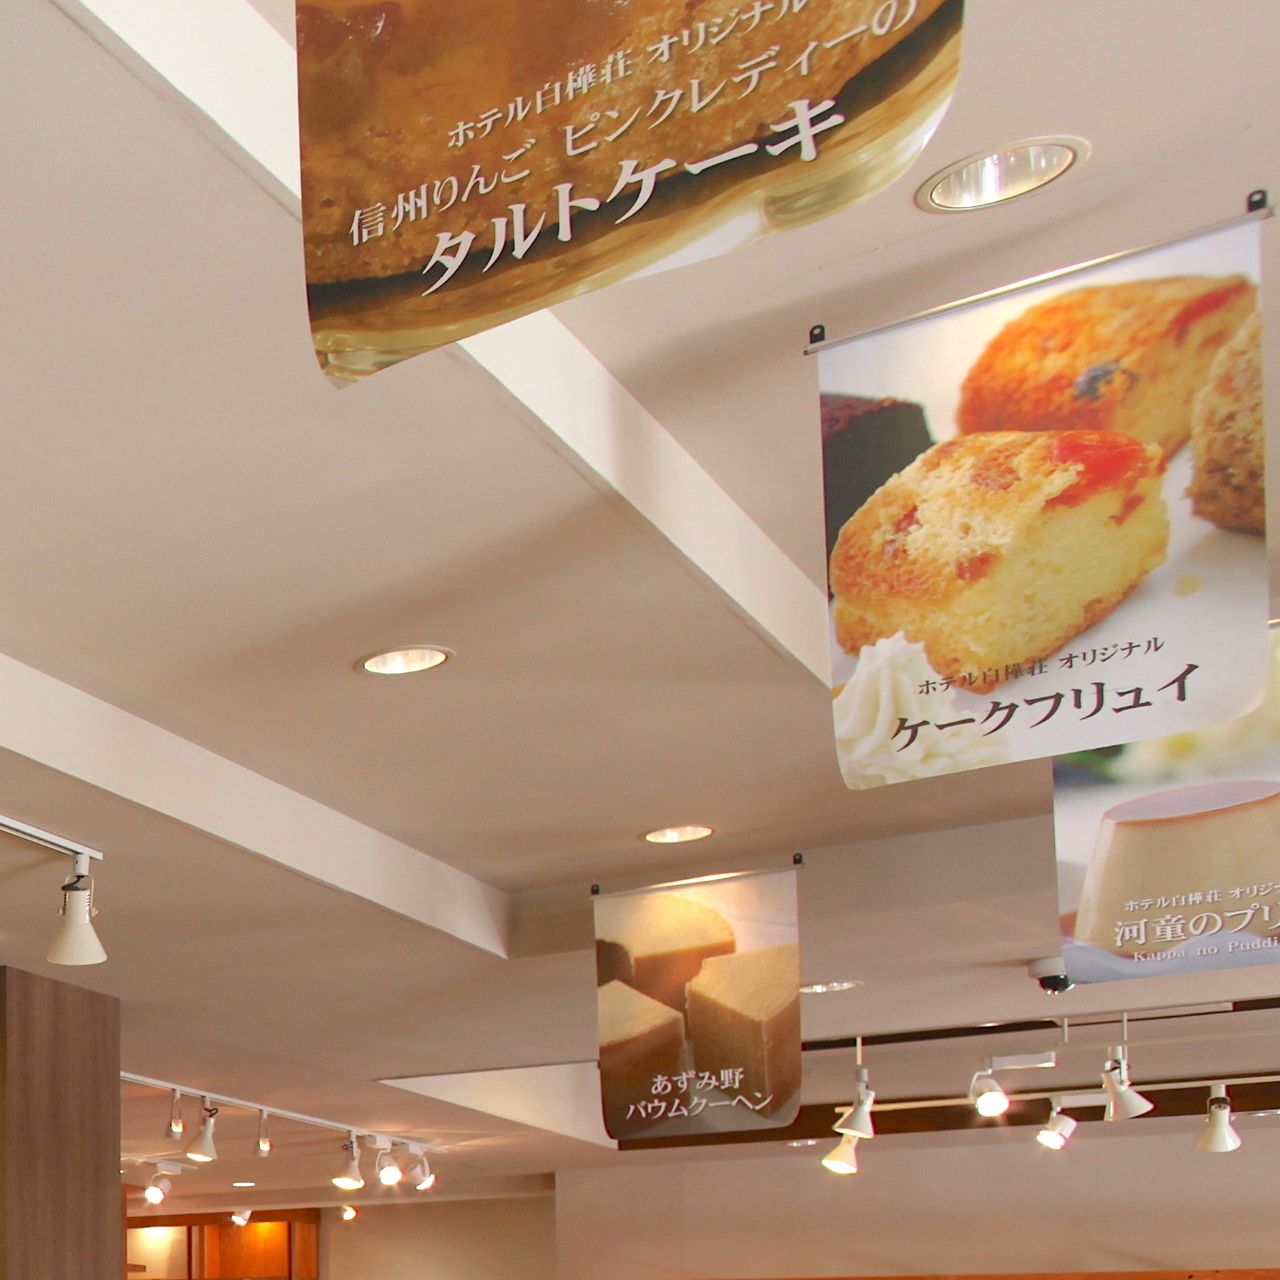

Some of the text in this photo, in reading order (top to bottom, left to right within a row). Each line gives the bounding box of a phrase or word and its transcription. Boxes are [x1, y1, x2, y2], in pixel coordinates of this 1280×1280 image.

[445, 0, 810, 149] ホテル白樺荘 オリジナル
[347, 0, 918, 247] 信州りんご ピンクレディーの
[420, 95, 846, 297] タルトケーキ
[918, 636, 1167, 697] ホテル白樺荘 オリジナル
[890, 662, 1202, 753] ケークフリュイ
[1229, 882, 1280, 900] オリジ
[1132, 945, 1188, 963] Kappa
[1196, 946, 1218, 956] no
[625, 1092, 774, 1120] バウムクーヘン
[651, 1067, 744, 1096] あずみ野
